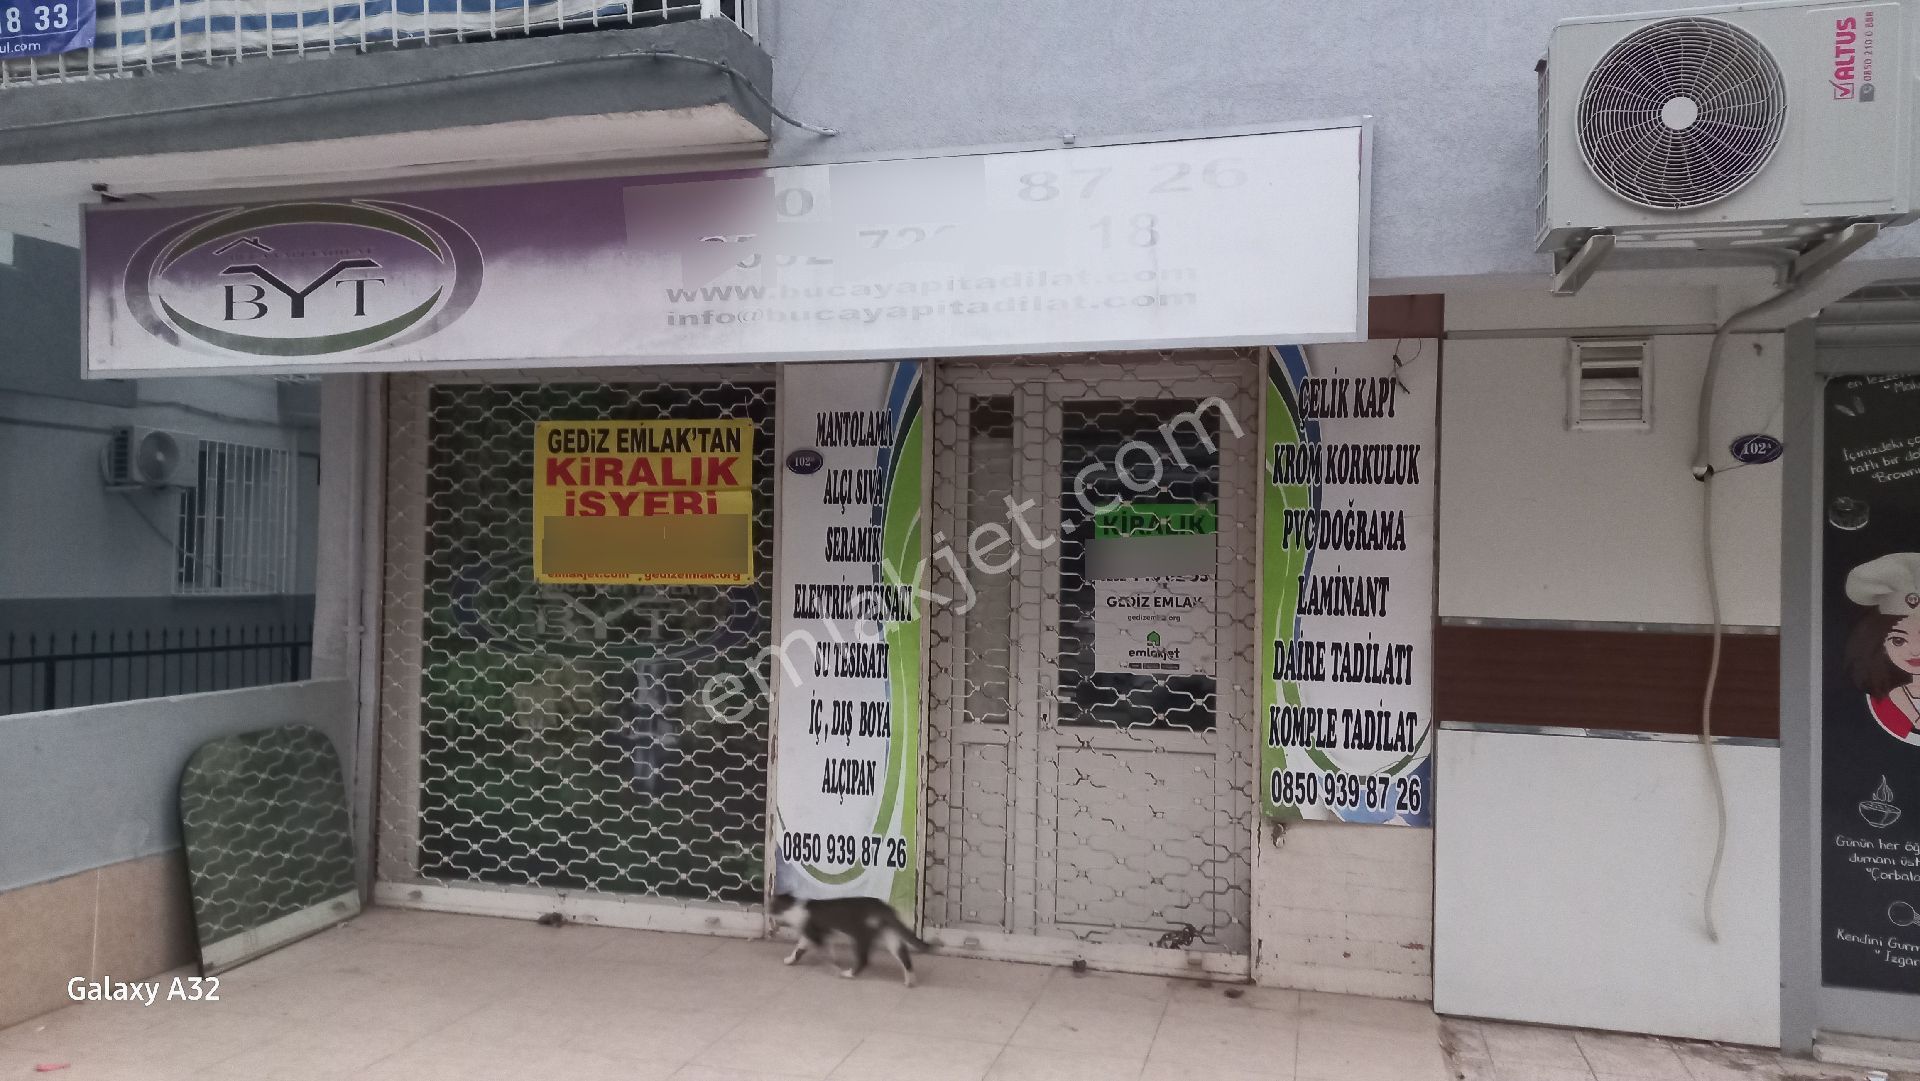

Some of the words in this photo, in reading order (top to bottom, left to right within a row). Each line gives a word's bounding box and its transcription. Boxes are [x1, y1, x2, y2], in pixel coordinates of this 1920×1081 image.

[0, 7, 21, 33] 8
[34, 4, 68, 30] 33
[1834, 17, 1857, 80] ALTUS
[219, 257, 386, 321] BYT
[1300, 367, 1350, 430] ÇELİK
[1353, 377, 1397, 418] KAPI
[815, 409, 894, 448] MANTOLAMA
[1273, 444, 1322, 485] KROM
[1325, 444, 1420, 485] KORKULUK
[823, 469, 852, 515] ALÇI
[855, 469, 883, 505] SIVA
[825, 518, 881, 563] SERAMİK
[1282, 509, 1316, 551] PVC
[1319, 499, 1406, 551] DOĞRAMA
[793, 574, 853, 620] ELEKTRİK
[1297, 565, 1389, 618] LAMİNANT
[814, 641, 830, 677] SU
[834, 633, 889, 679] TESİSATI
[1273, 630, 1326, 682] DAİRE
[1331, 632, 1413, 685] TADİLATI
[831, 700, 853, 746] DIŞ
[859, 701, 890, 738] BOYA
[1269, 706, 1337, 749] KOMPLE
[1342, 699, 1417, 752] TADİLAT
[822, 757, 876, 805] ALÇIPAN
[1272, 771, 1318, 806] 0850
[1325, 773, 1359, 808] 939
[1366, 776, 1390, 809] 87
[1396, 778, 1421, 812] 26
[783, 832, 821, 863] 0850
[827, 834, 855, 866] 939
[861, 836, 881, 866] 87
[887, 838, 906, 868] 26
[1879, 838, 1900, 850] her
